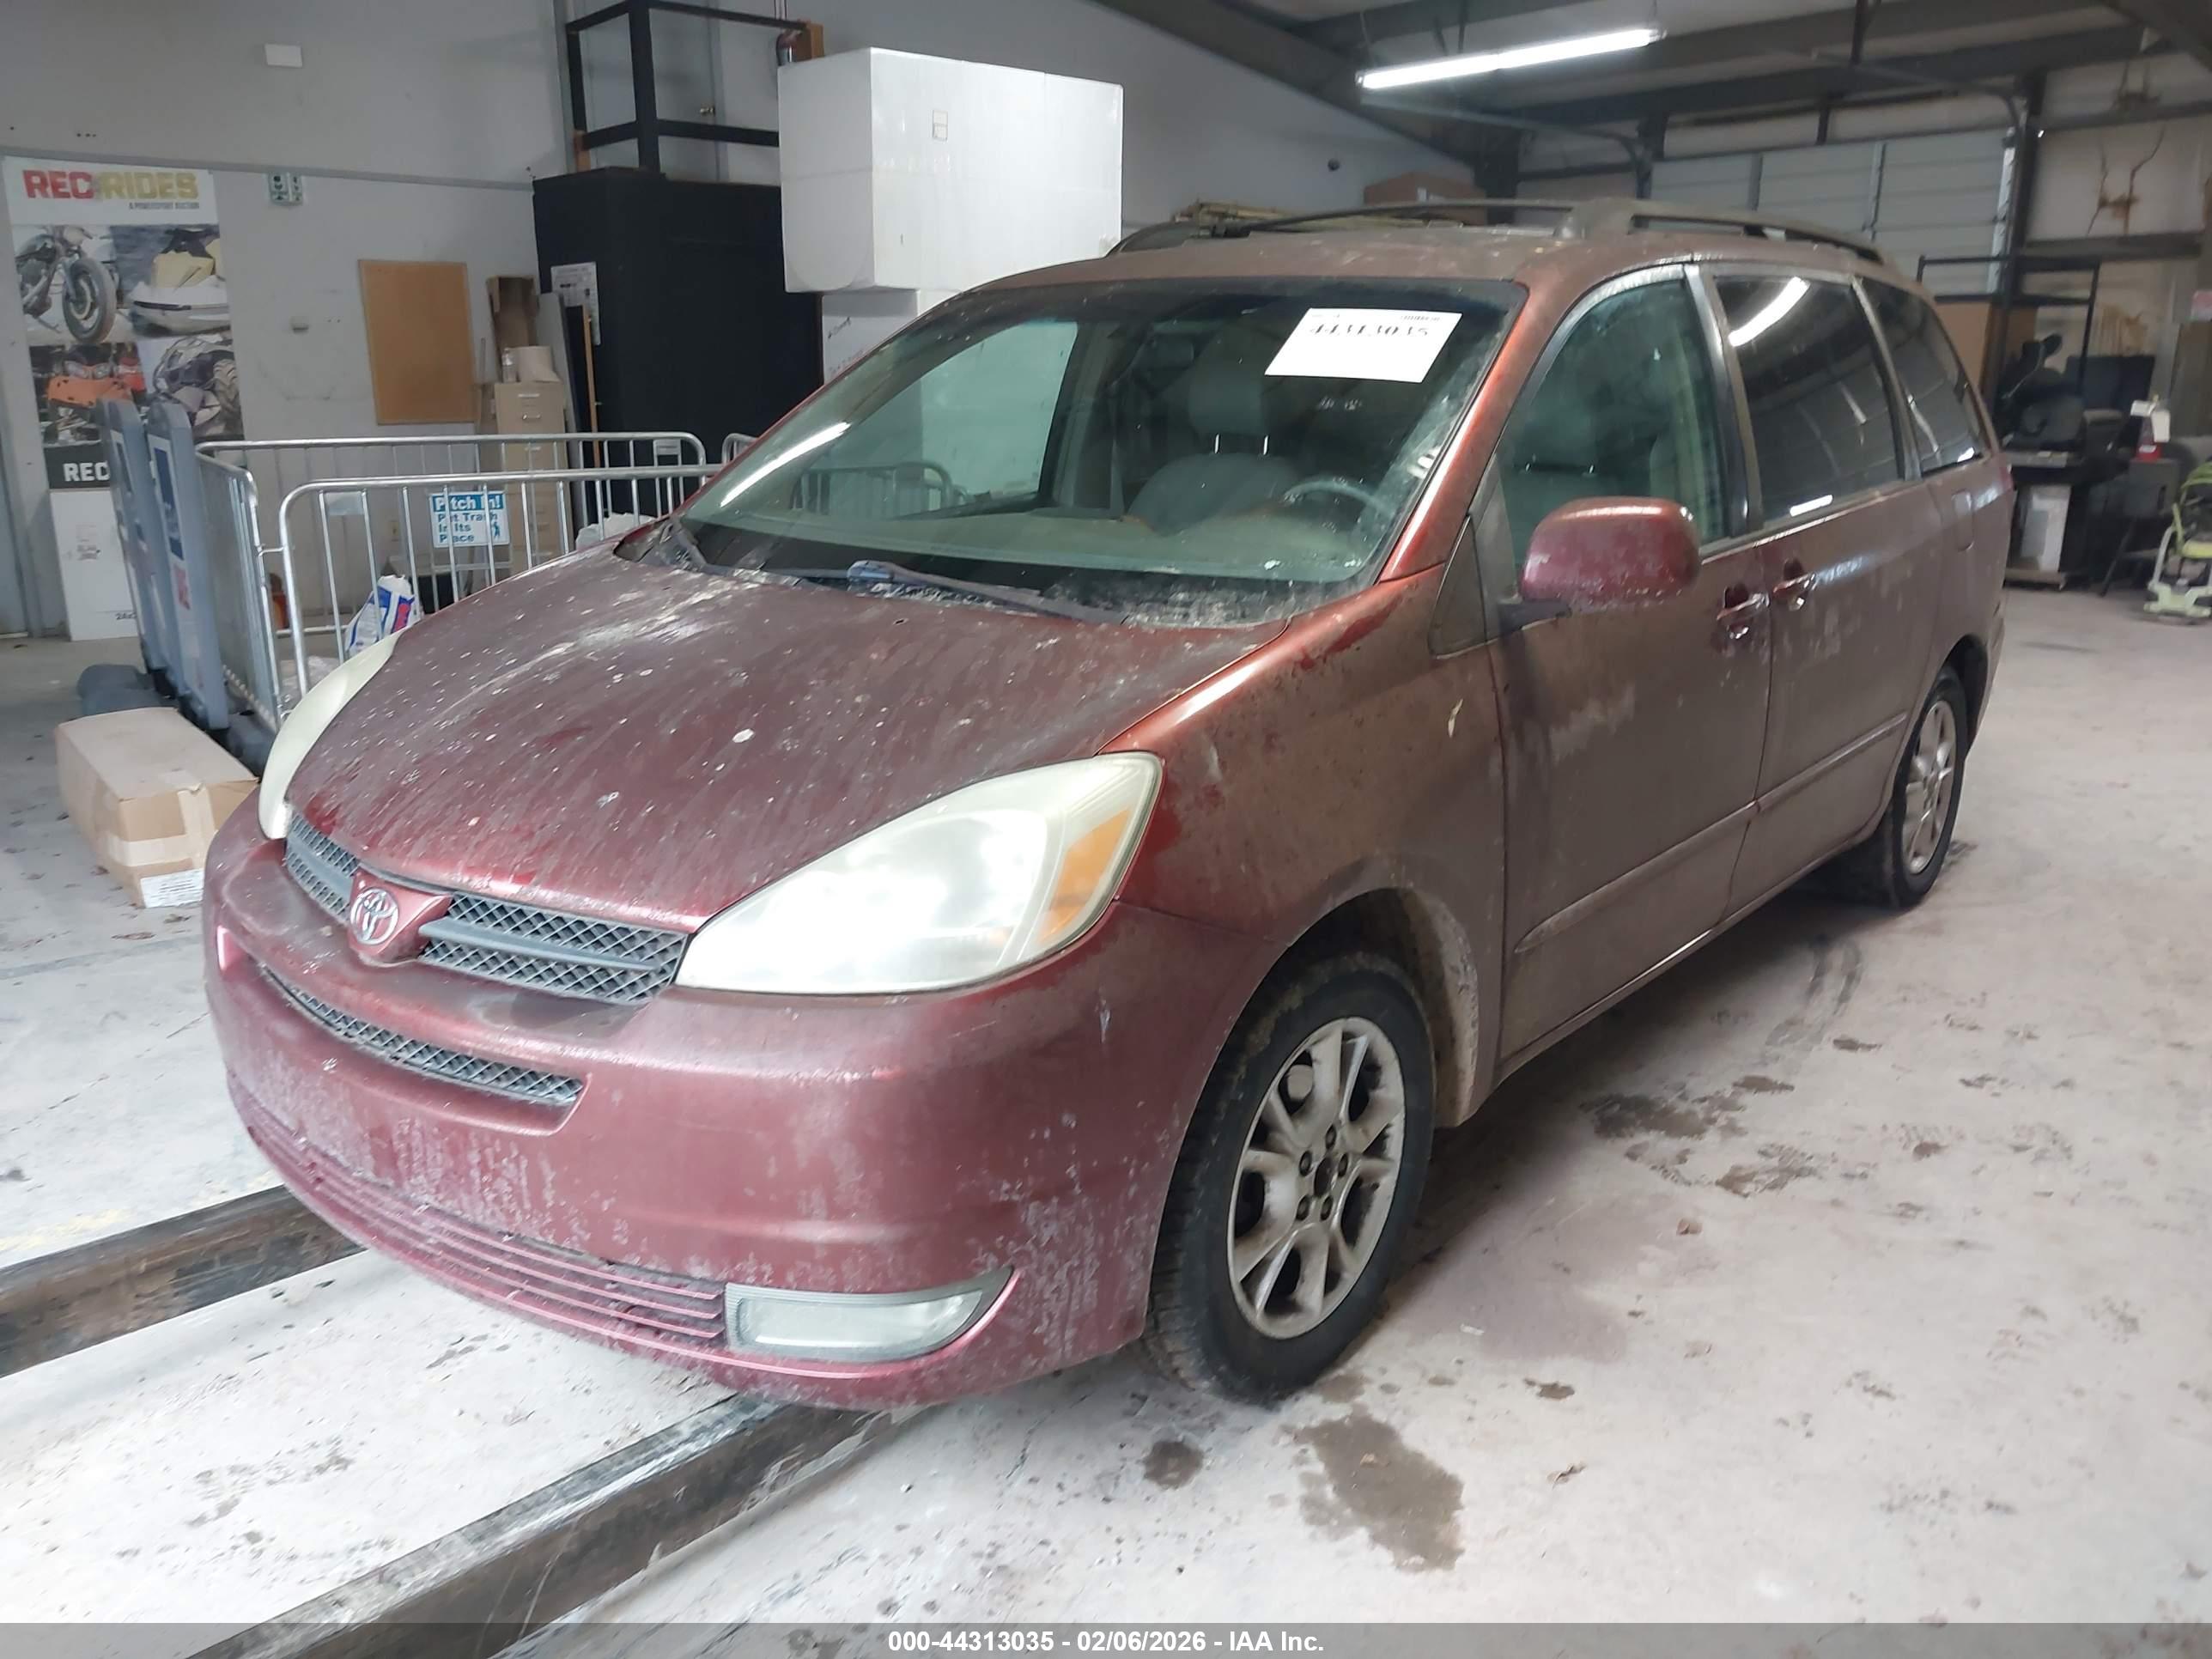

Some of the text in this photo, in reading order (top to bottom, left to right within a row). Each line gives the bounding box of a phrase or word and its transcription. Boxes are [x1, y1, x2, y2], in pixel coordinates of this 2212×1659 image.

[434, 495, 477, 510] Ptch
[438, 511, 498, 522] Pt Trah
[454, 523, 471, 532] Its
[439, 533, 475, 543] Pace
